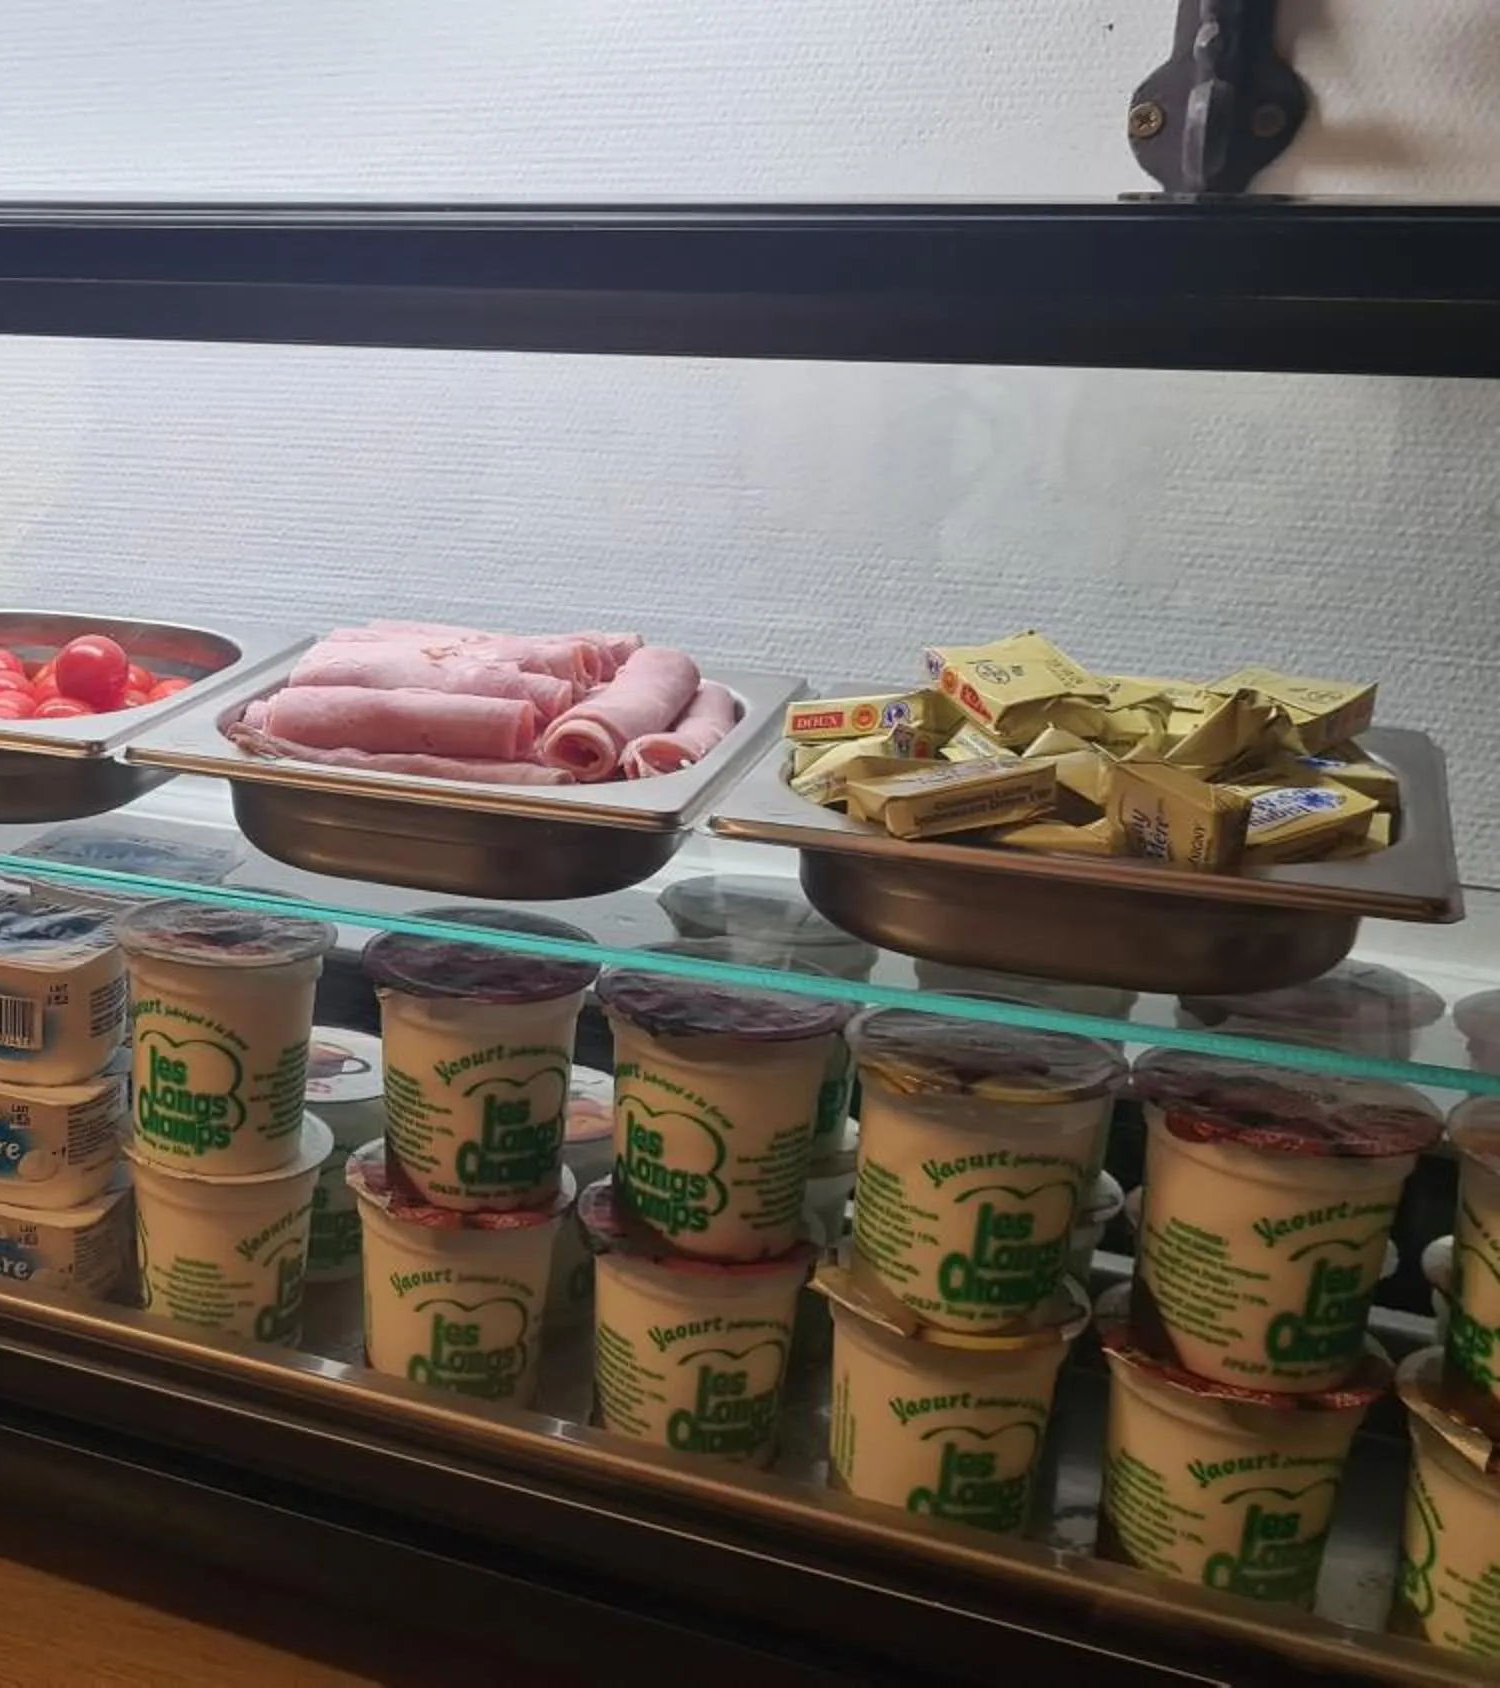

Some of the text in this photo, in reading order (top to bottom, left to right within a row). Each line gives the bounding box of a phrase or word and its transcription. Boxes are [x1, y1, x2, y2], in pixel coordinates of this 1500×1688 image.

[921, 1151, 1009, 1187] Yaourt
[1252, 1202, 1349, 1248] Yaourt
[648, 1317, 723, 1352] Yaourt
[889, 1393, 971, 1425] Yaourt
[1187, 1453, 1279, 1488] Yaourt
